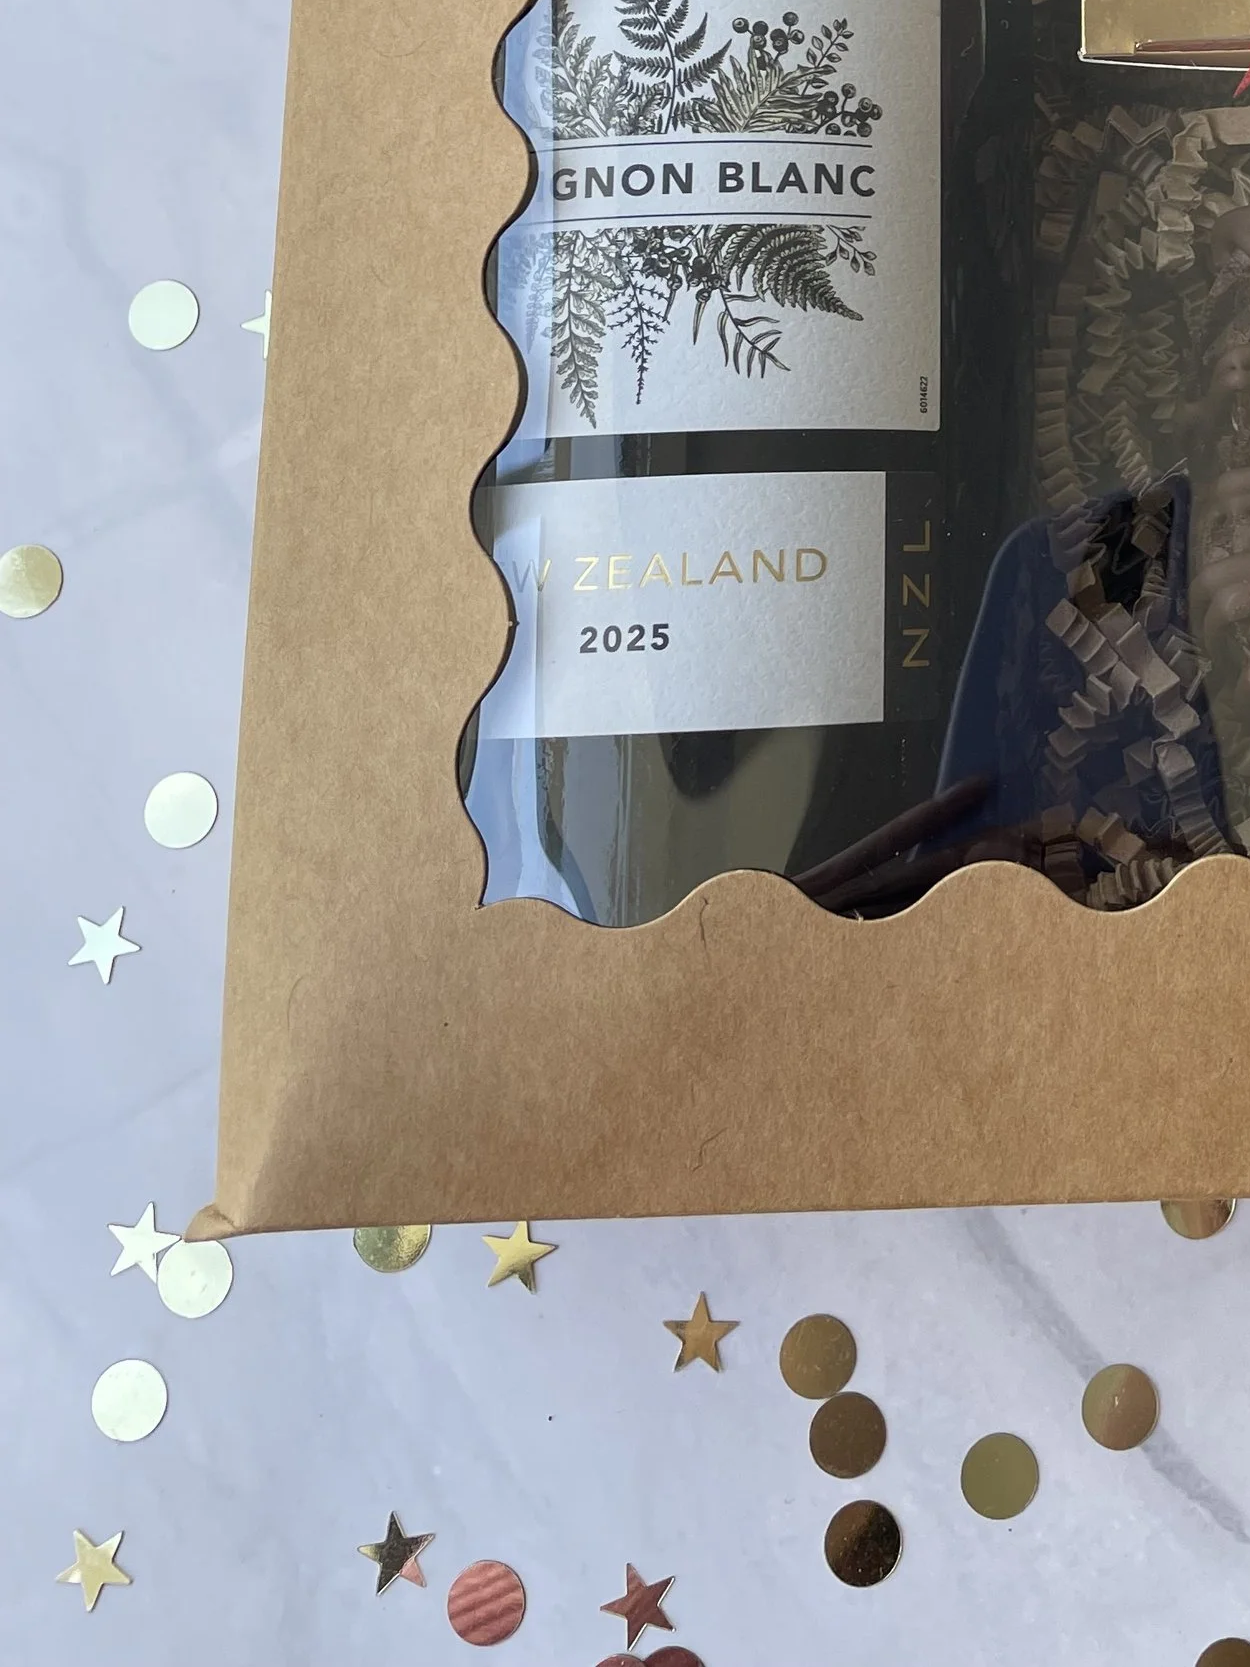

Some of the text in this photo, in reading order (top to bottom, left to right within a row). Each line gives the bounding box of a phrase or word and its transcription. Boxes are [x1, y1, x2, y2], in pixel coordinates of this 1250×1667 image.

[718, 161, 876, 198] BLANC
[573, 547, 828, 593] ZEALAND
[902, 520, 931, 668] NZL
[579, 623, 670, 654] 2025
